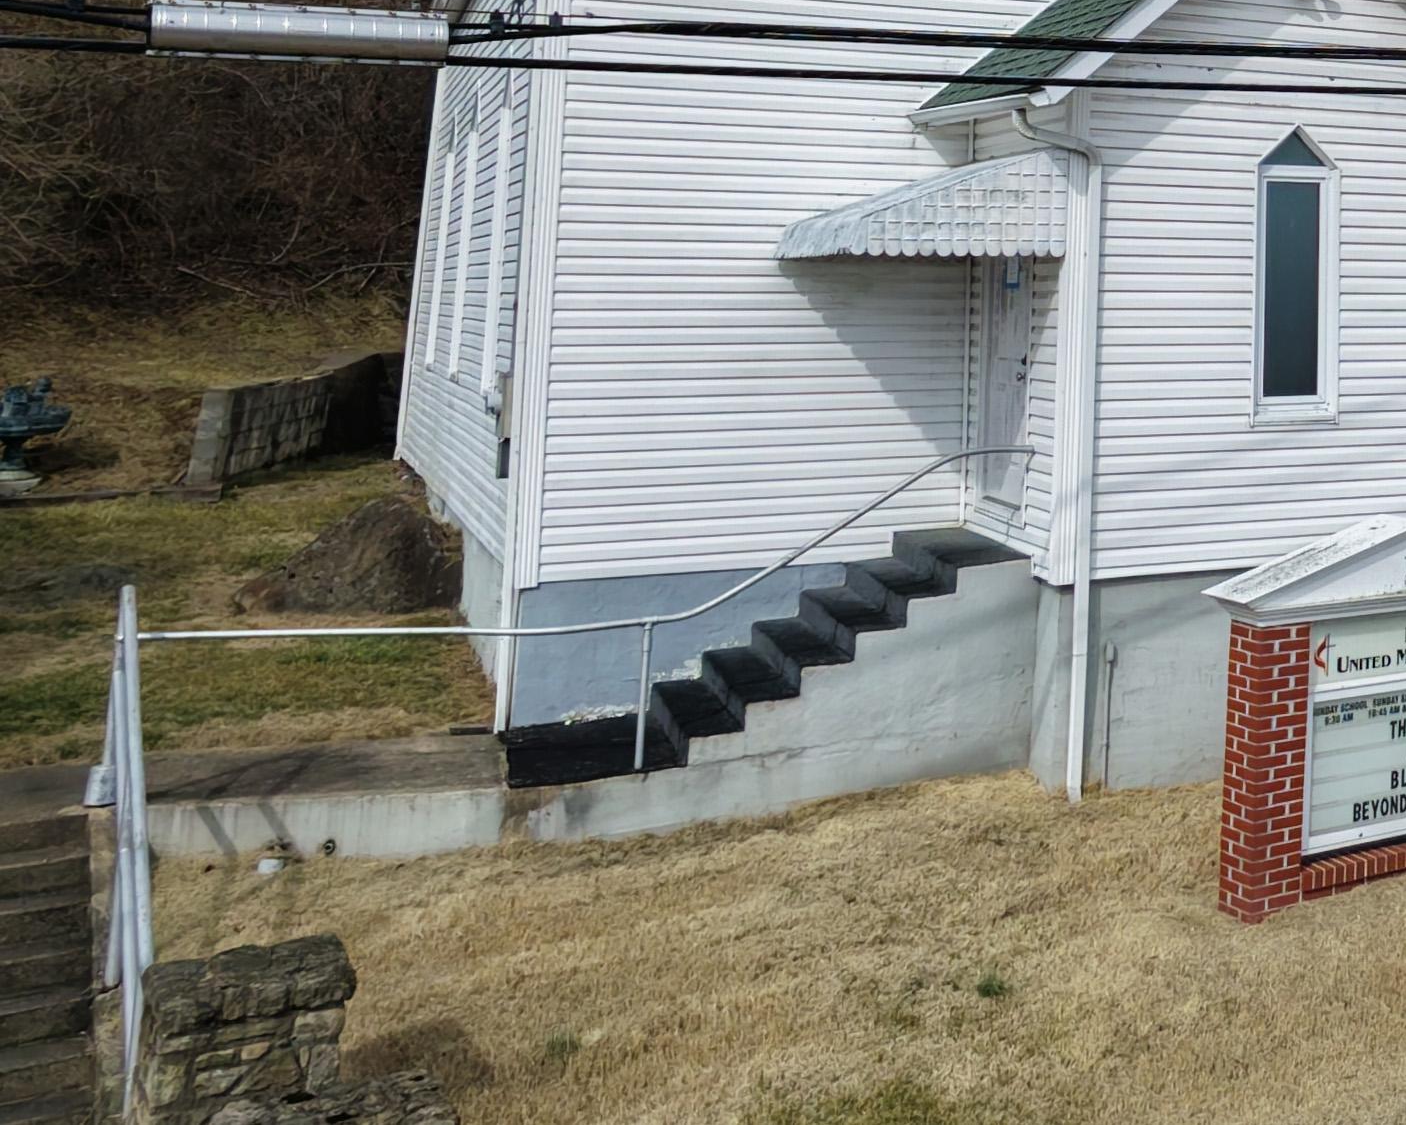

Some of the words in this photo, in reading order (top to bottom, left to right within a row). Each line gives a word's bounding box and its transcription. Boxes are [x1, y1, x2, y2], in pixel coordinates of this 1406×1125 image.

[1337, 654, 1391, 673] UNITED
[1340, 700, 1368, 713] SCHOOL
[1373, 695, 1399, 708] SUNDAY
[1389, 705, 1401, 715] AM
[1342, 712, 1354, 724] AM
